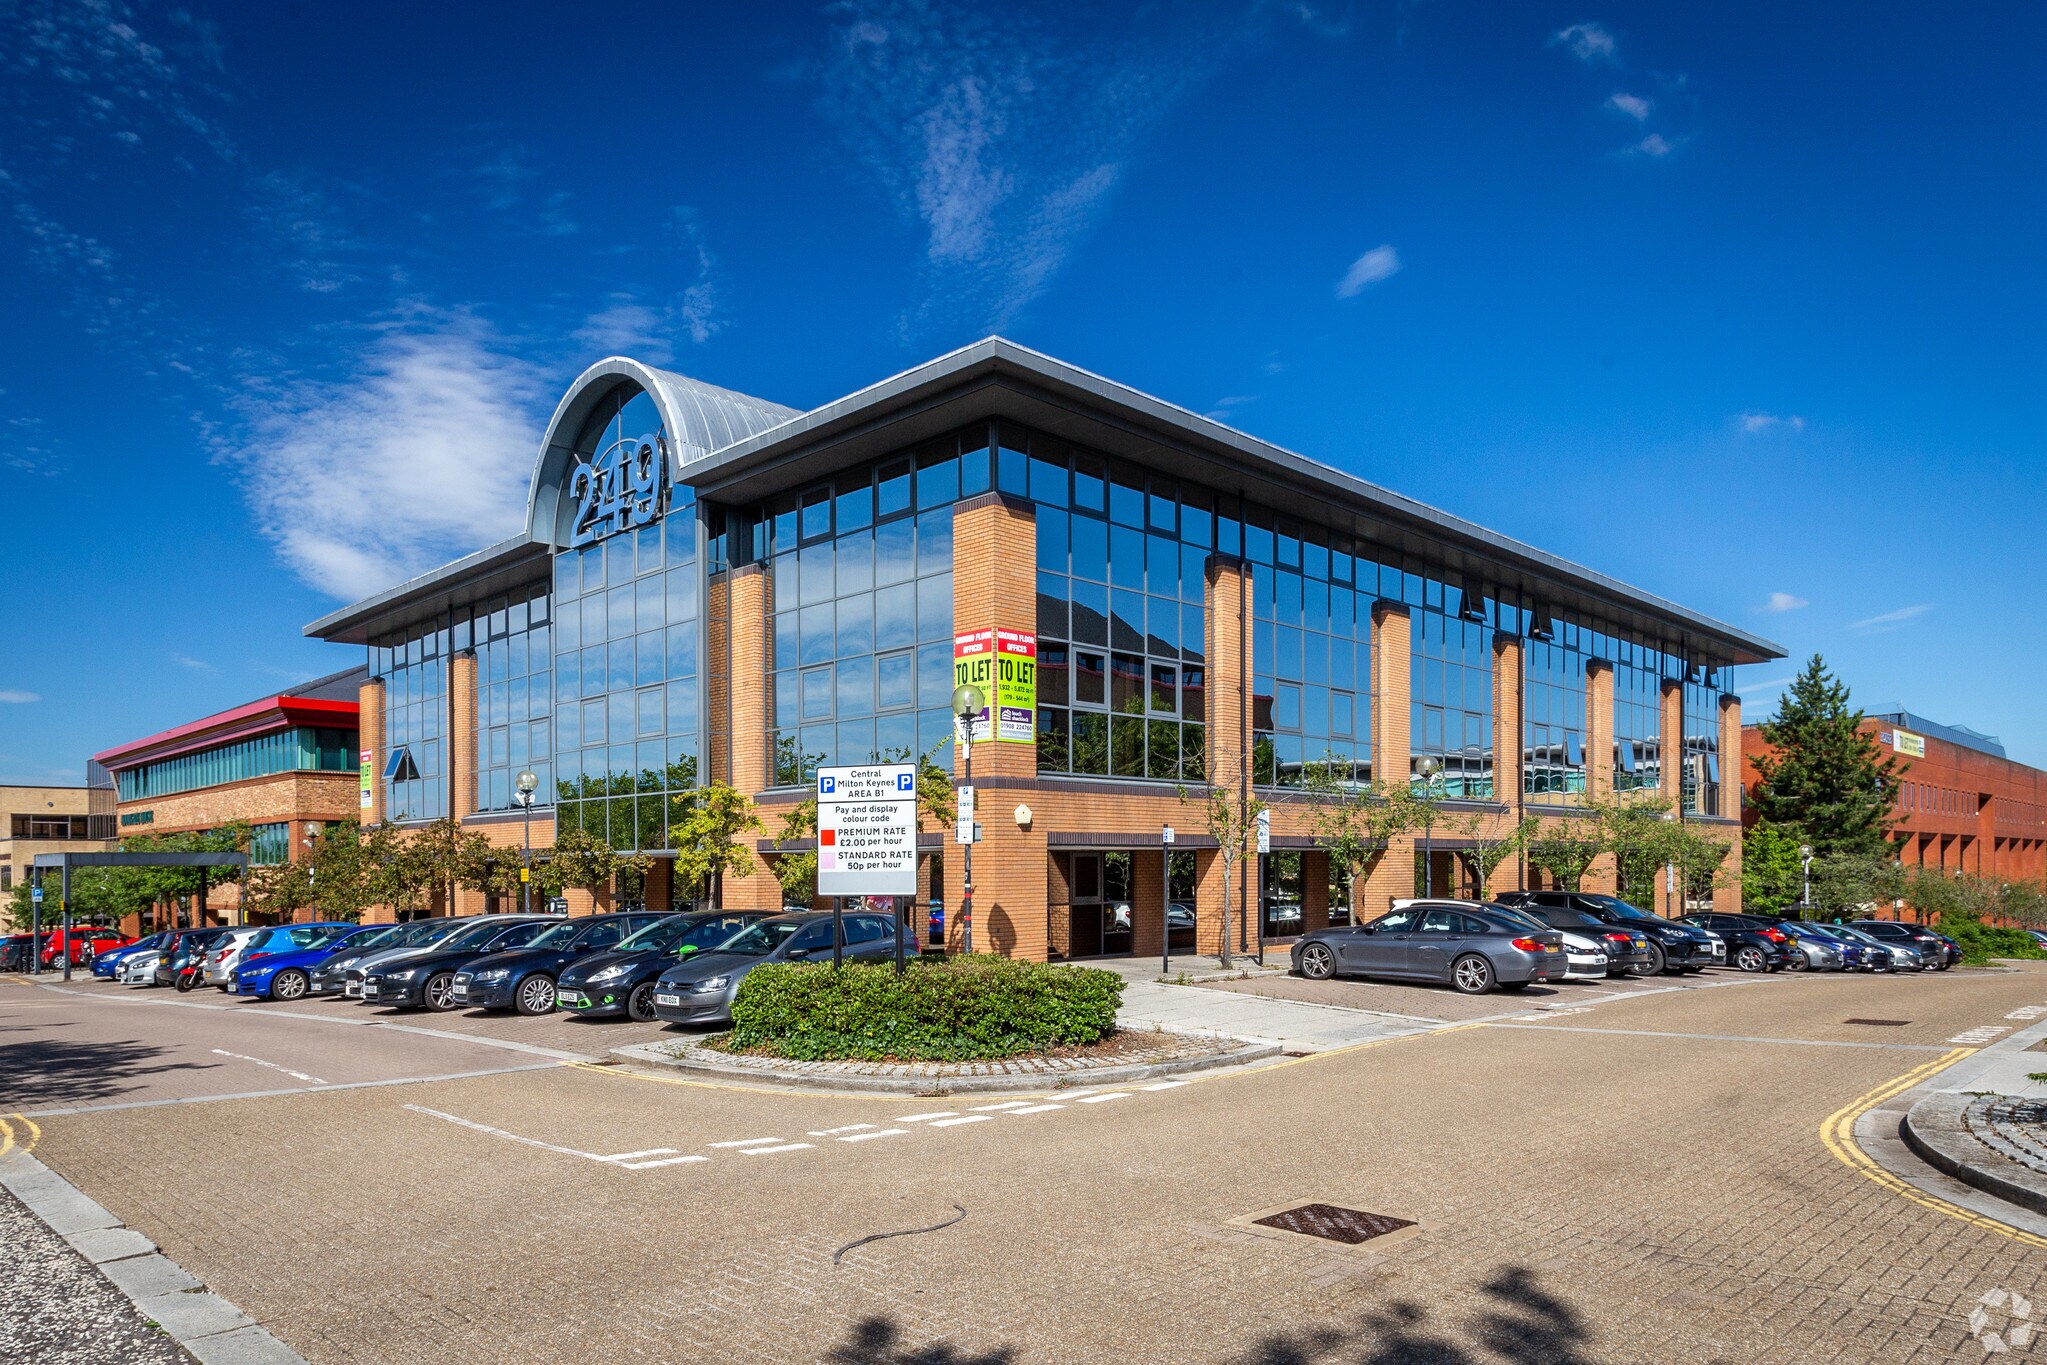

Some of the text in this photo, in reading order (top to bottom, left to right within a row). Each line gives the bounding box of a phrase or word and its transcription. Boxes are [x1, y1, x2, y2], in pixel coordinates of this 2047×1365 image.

[569, 432, 663, 548] 249
[1019, 634, 1035, 644] FLOOR
[1006, 643, 1027, 653] OFFICES
[956, 659, 992, 685] TO LET
[998, 658, 1035, 685] TO LET
[1000, 722, 1015, 730] 01908
[850, 769, 882, 778] Central
[823, 775, 911, 792] P Milton Keynes P
[848, 789, 885, 798] AREA B1
[835, 804, 898, 815] Pay and display
[842, 814, 890, 823] colour code
[838, 827, 906, 836] PREMIUM RATE
[840, 837, 903, 847] £2.00 per hour
[838, 851, 913, 860] STANDARD RATE
[847, 861, 902, 871] 50p per hour
